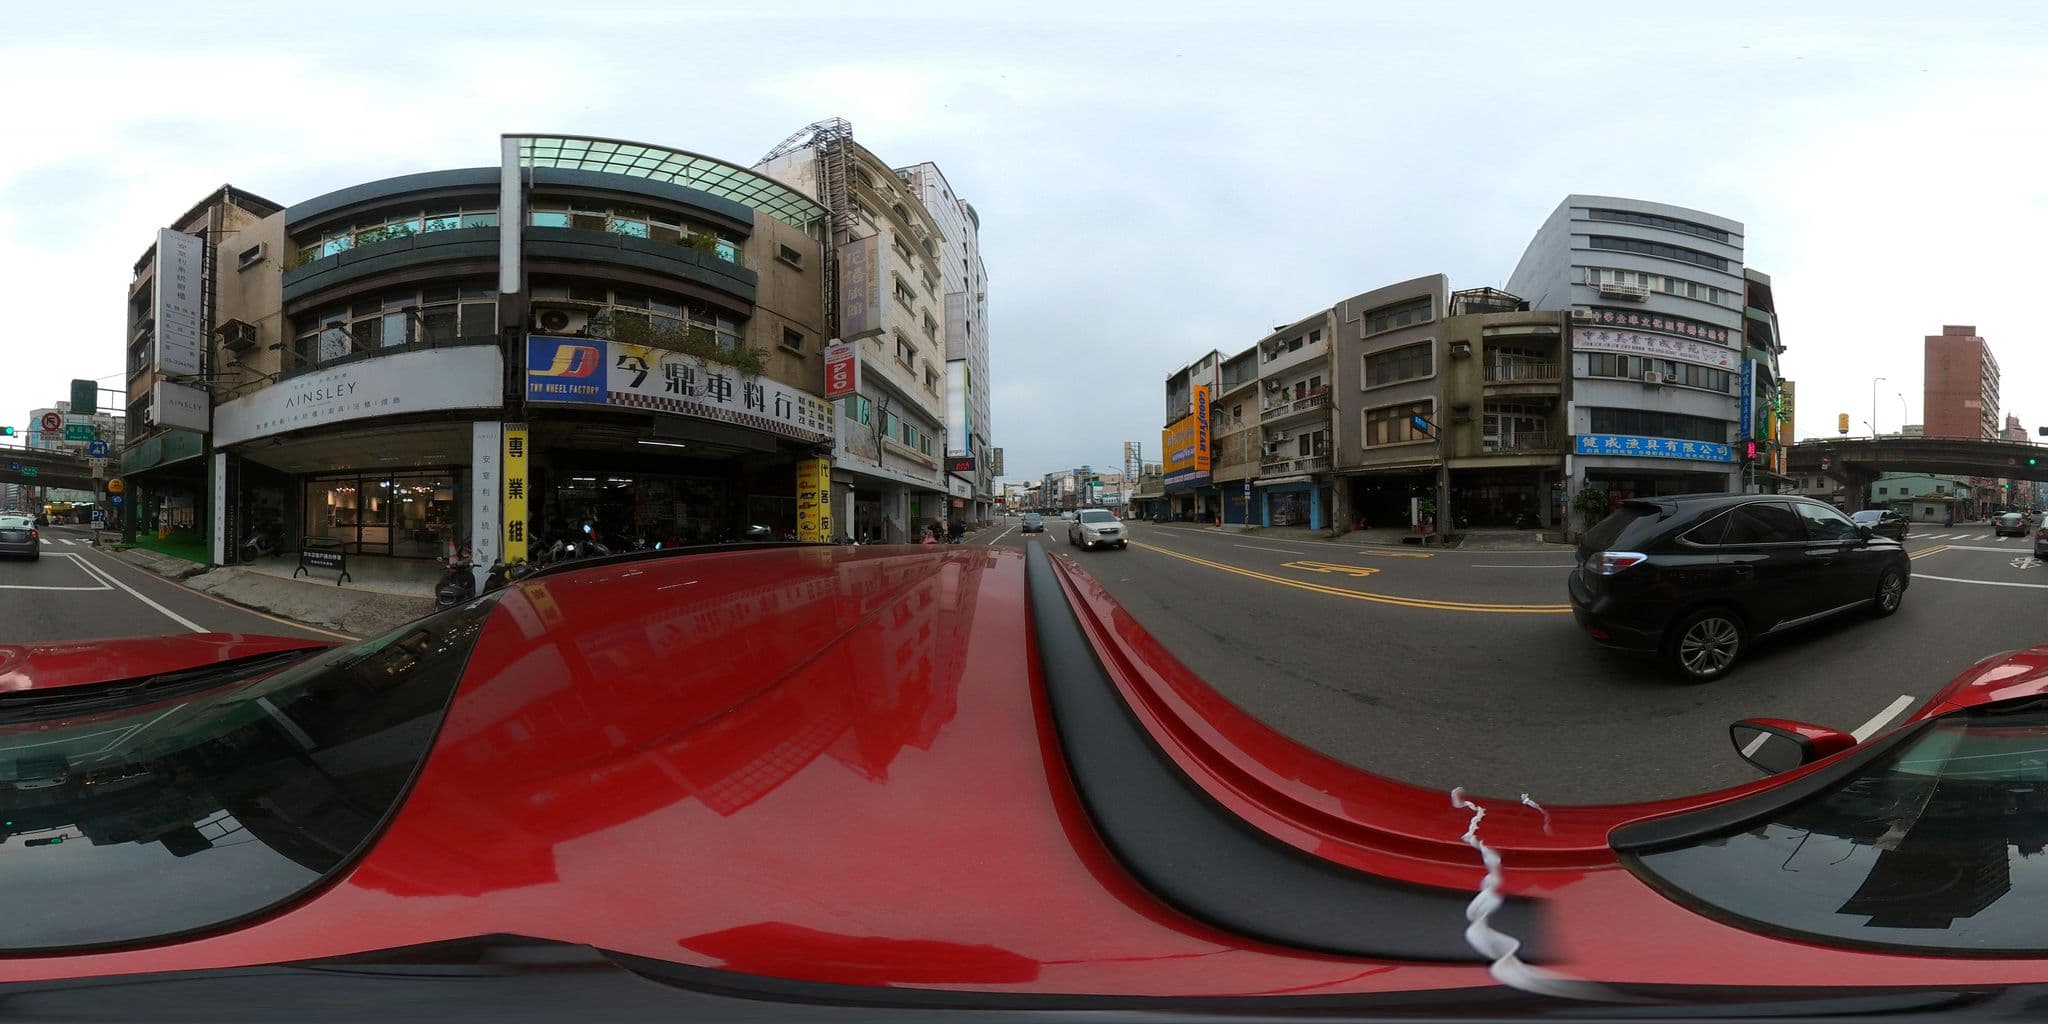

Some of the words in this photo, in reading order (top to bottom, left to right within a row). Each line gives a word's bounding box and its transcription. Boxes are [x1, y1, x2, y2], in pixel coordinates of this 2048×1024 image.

[286, 381, 357, 409] AINSLEY
[546, 383, 568, 394] WHEEL
[569, 384, 600, 395] FACTORY
[616, 354, 793, 420] 今鼎車料行
[1199, 390, 1208, 451] GOODYEAR
